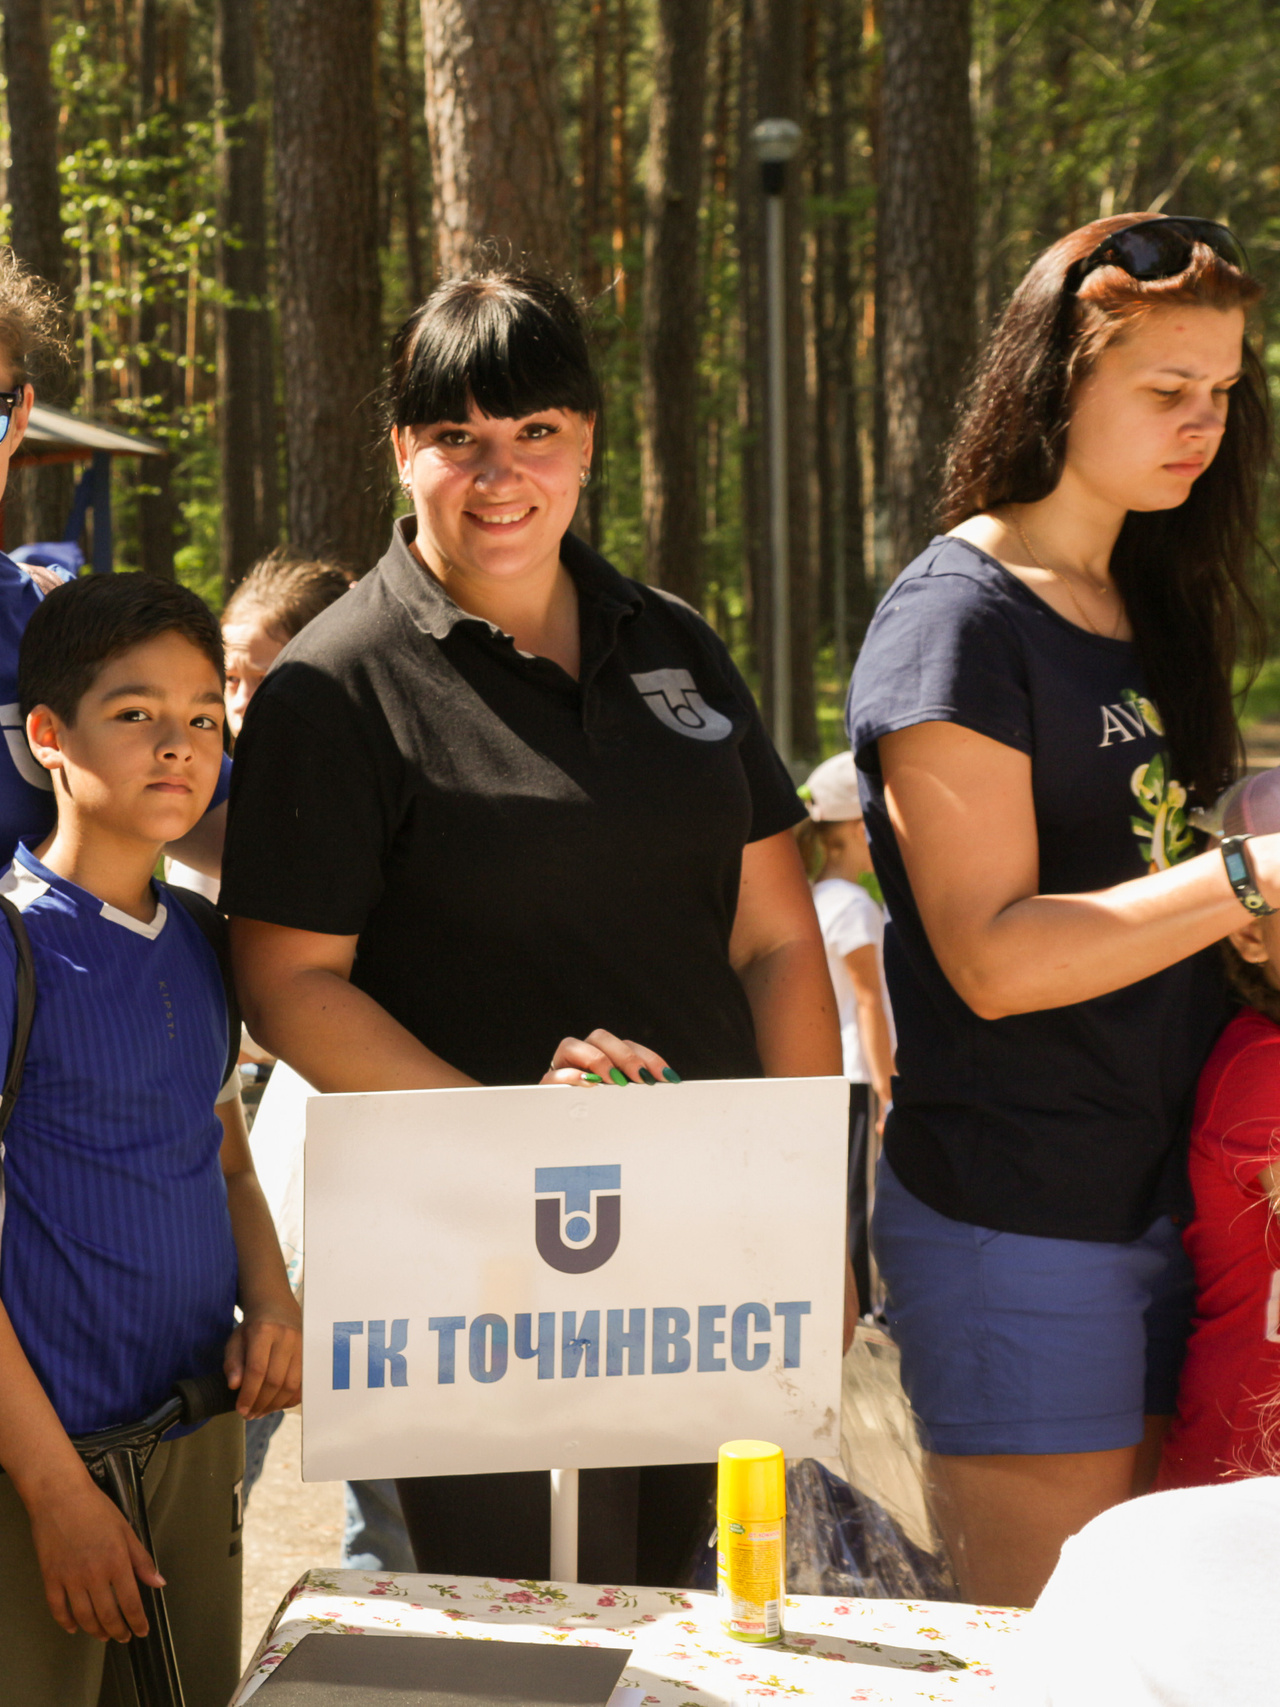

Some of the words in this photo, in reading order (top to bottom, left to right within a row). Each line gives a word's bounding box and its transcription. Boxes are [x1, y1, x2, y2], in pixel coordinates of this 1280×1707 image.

[158, 981, 176, 1040] KIPSTA
[332, 1318, 409, 1390] ГК
[428, 1301, 812, 1385] ТОЧИНВЕСТ
